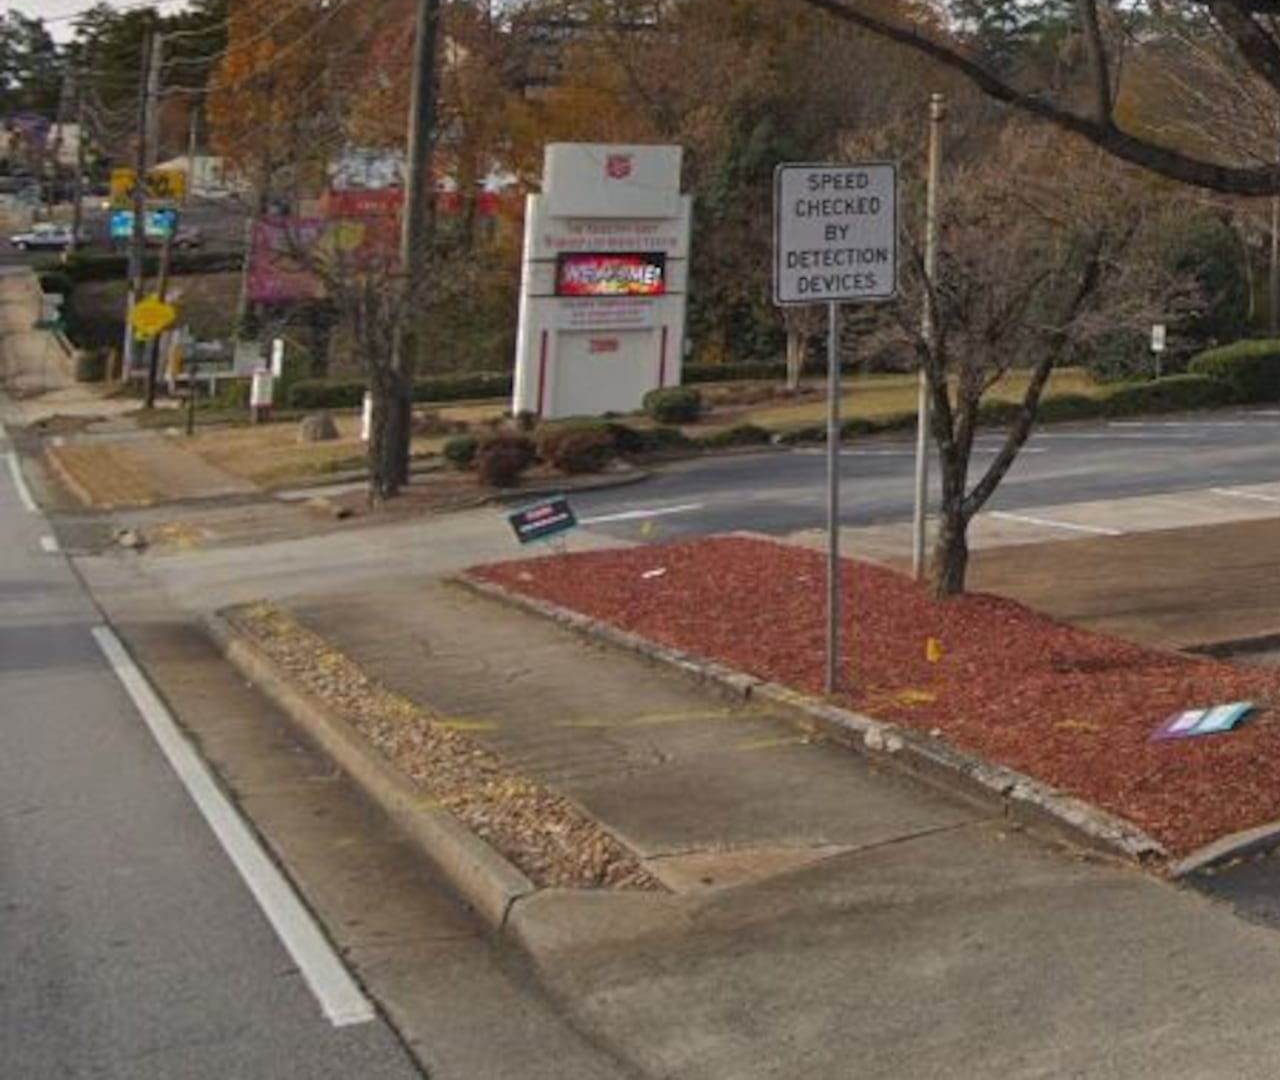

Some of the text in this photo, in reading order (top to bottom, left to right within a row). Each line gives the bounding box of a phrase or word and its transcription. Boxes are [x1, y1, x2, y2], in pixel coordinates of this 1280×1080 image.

[808, 172, 869, 191] SPEED
[795, 196, 881, 218] CHECKED
[824, 224, 850, 241] BY
[786, 247, 889, 270] DETECTION
[797, 271, 879, 294] DEVICES
